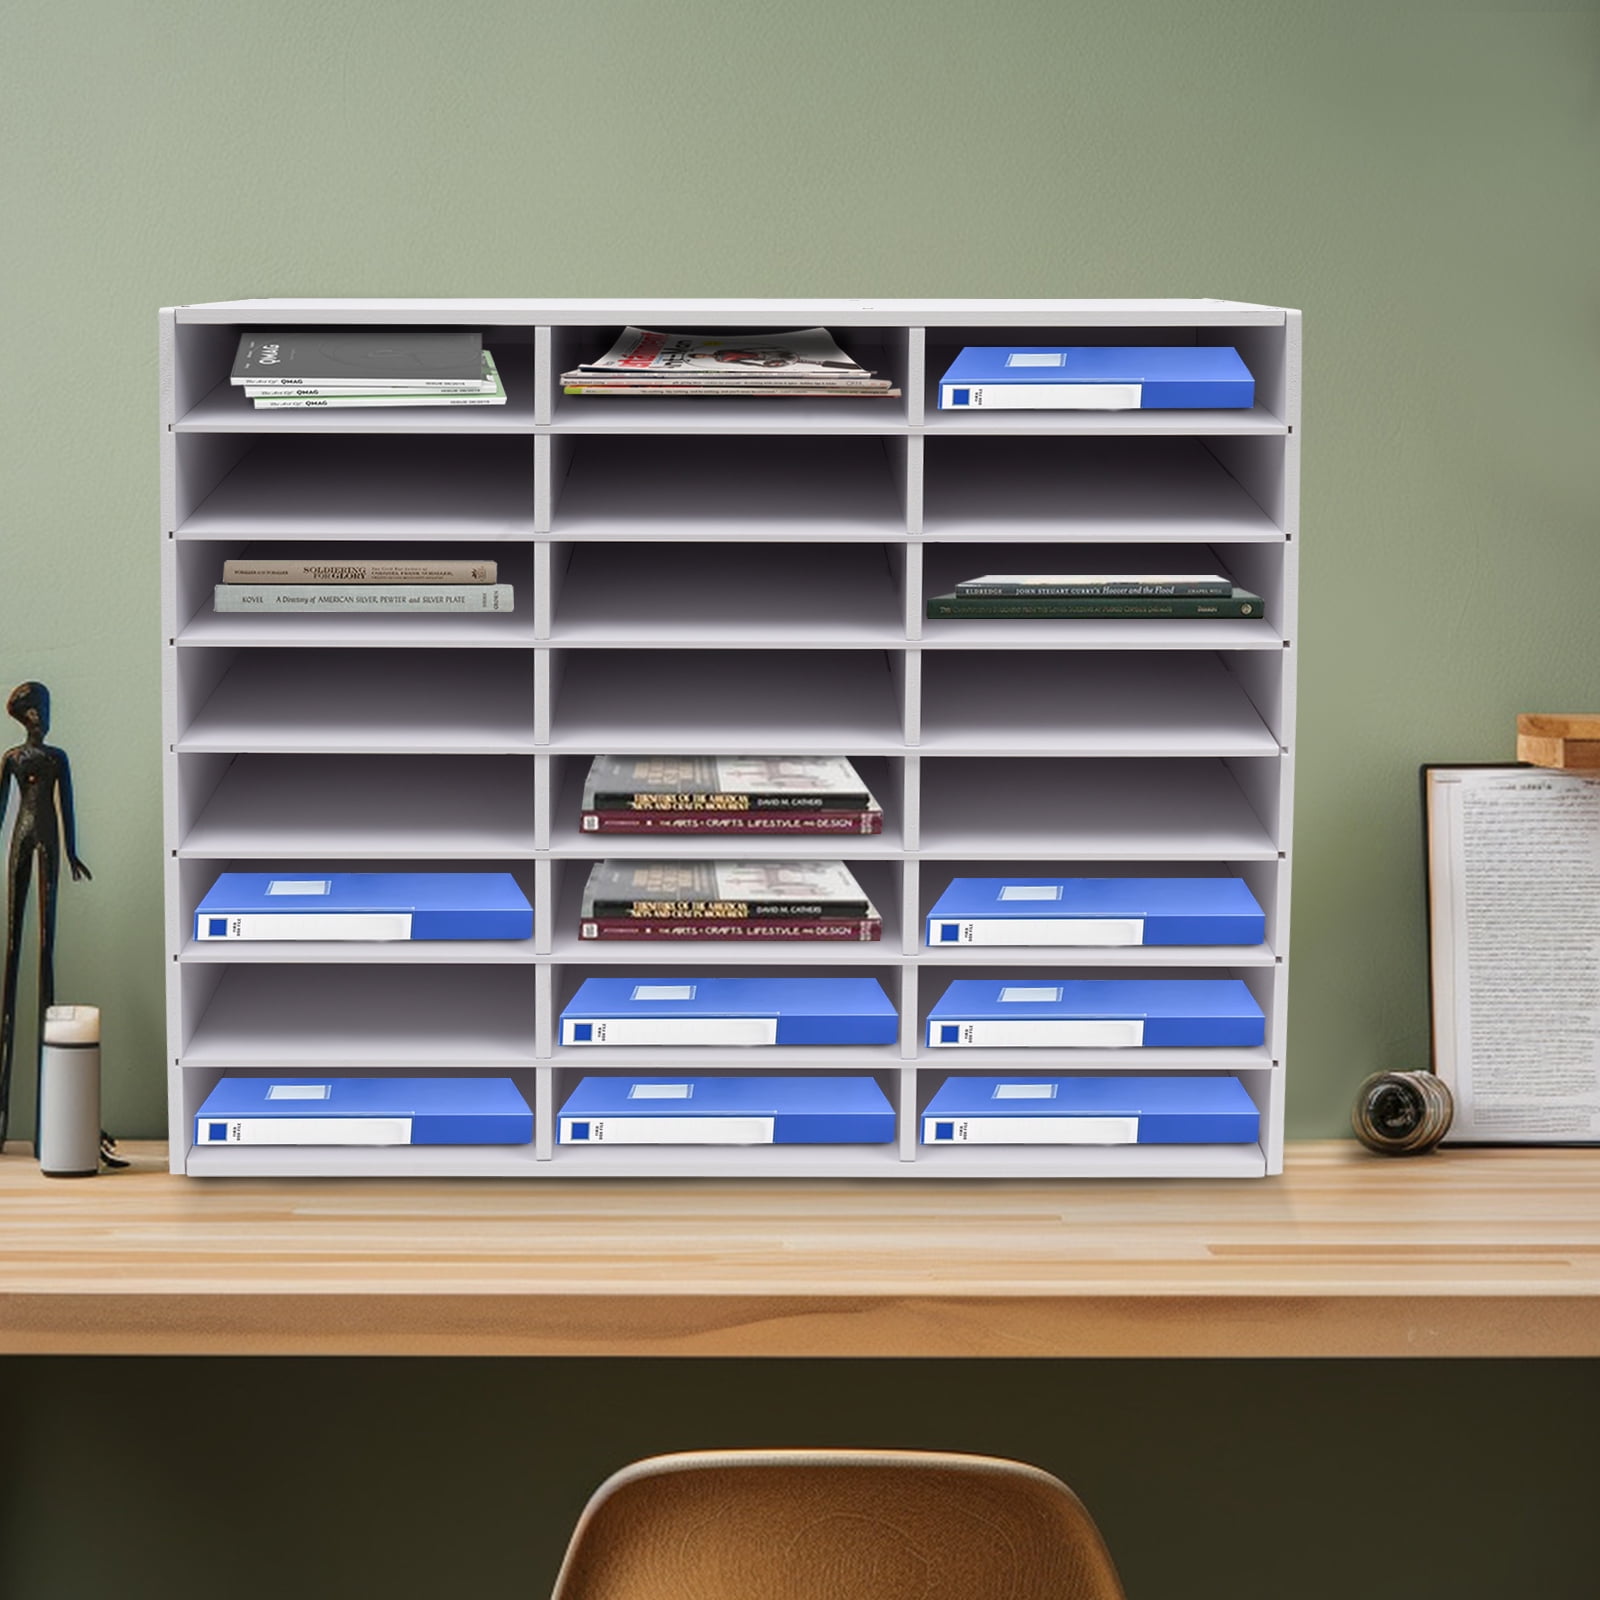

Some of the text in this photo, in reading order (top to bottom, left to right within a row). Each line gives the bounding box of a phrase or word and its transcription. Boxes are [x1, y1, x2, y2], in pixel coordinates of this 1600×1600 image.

[258, 344, 280, 365] QMAG
[303, 566, 367, 574] SOLDIERING
[318, 595, 355, 604] AMERICAN
[380, 596, 407, 604] PEWTER
[422, 596, 444, 604] SILVER
[445, 596, 467, 604] PLATE
[671, 819, 699, 827] ARTS
[706, 819, 744, 827] CRAFTS
[747, 819, 801, 827] LIFESTYLE
[817, 819, 854, 827] DESIGN
[670, 927, 698, 935] ARTS
[705, 927, 743, 935] CRAFTS
[746, 927, 800, 935] LIFESTYLE
[816, 927, 853, 935] DESIGN
